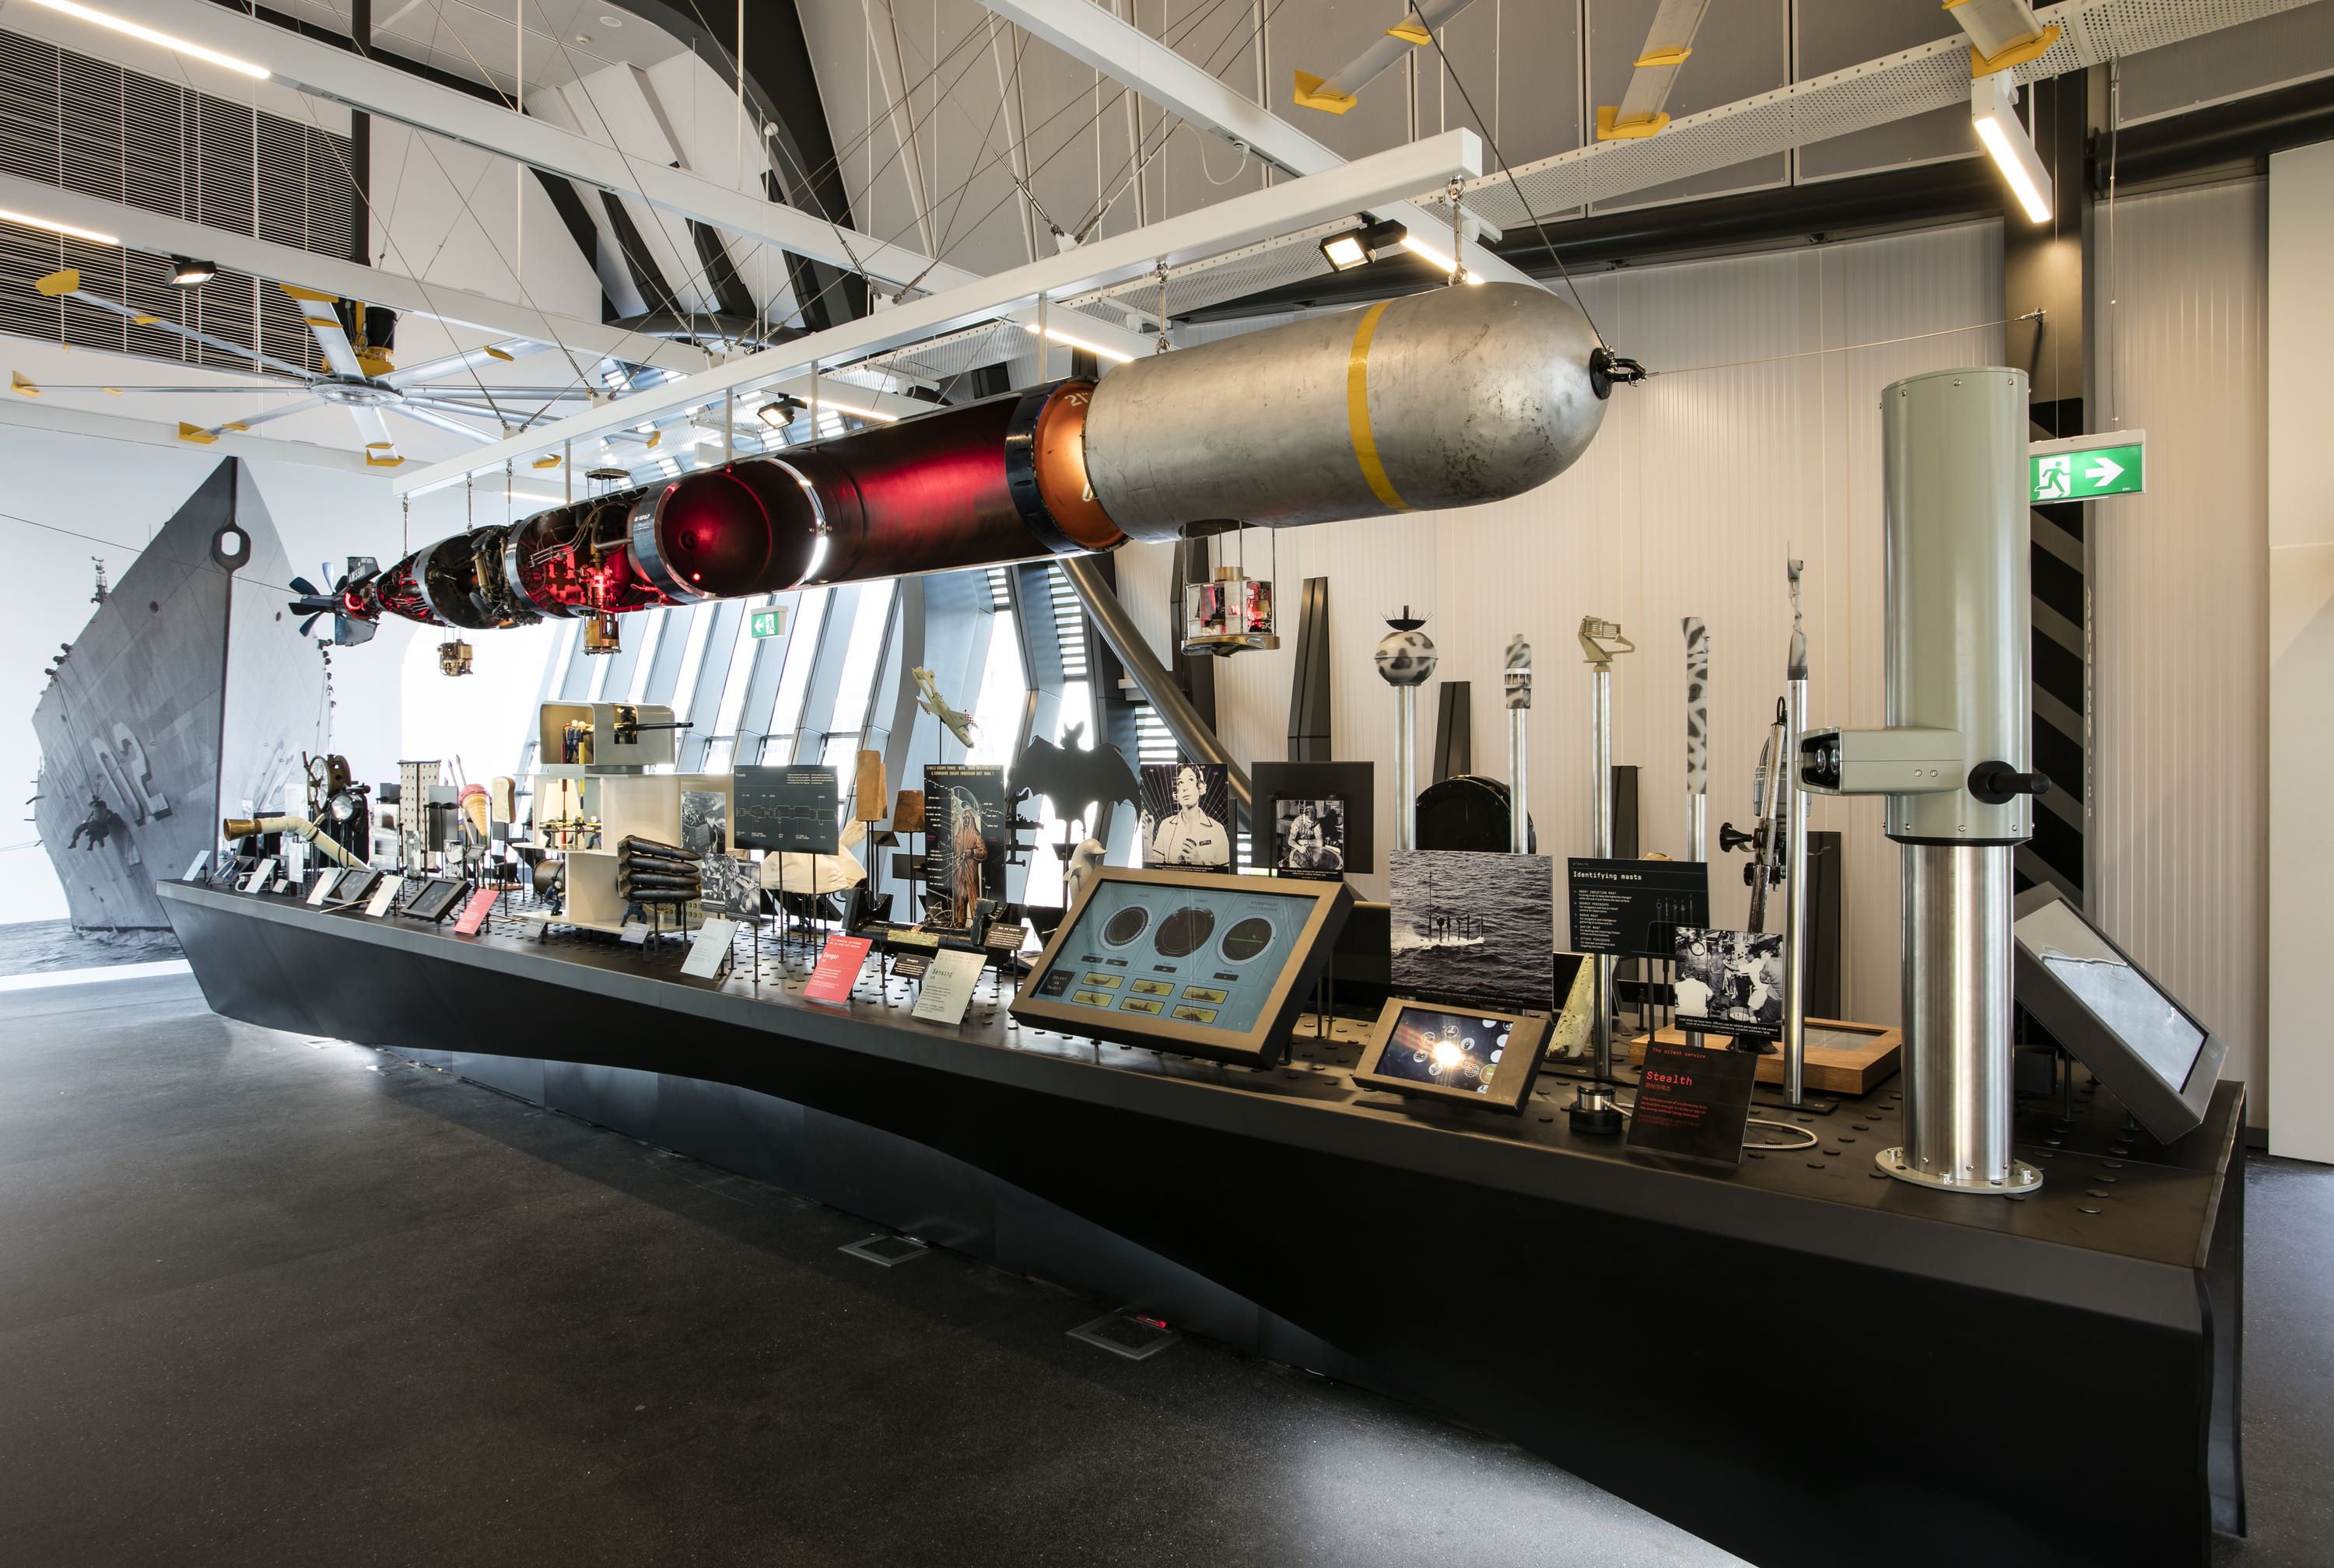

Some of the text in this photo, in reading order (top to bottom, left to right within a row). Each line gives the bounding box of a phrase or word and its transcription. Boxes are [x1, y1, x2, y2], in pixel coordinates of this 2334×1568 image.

[1573, 871, 1617, 880] Identifying
[932, 968, 953, 978] Sensing
[1646, 1071, 1692, 1086] Stealth
